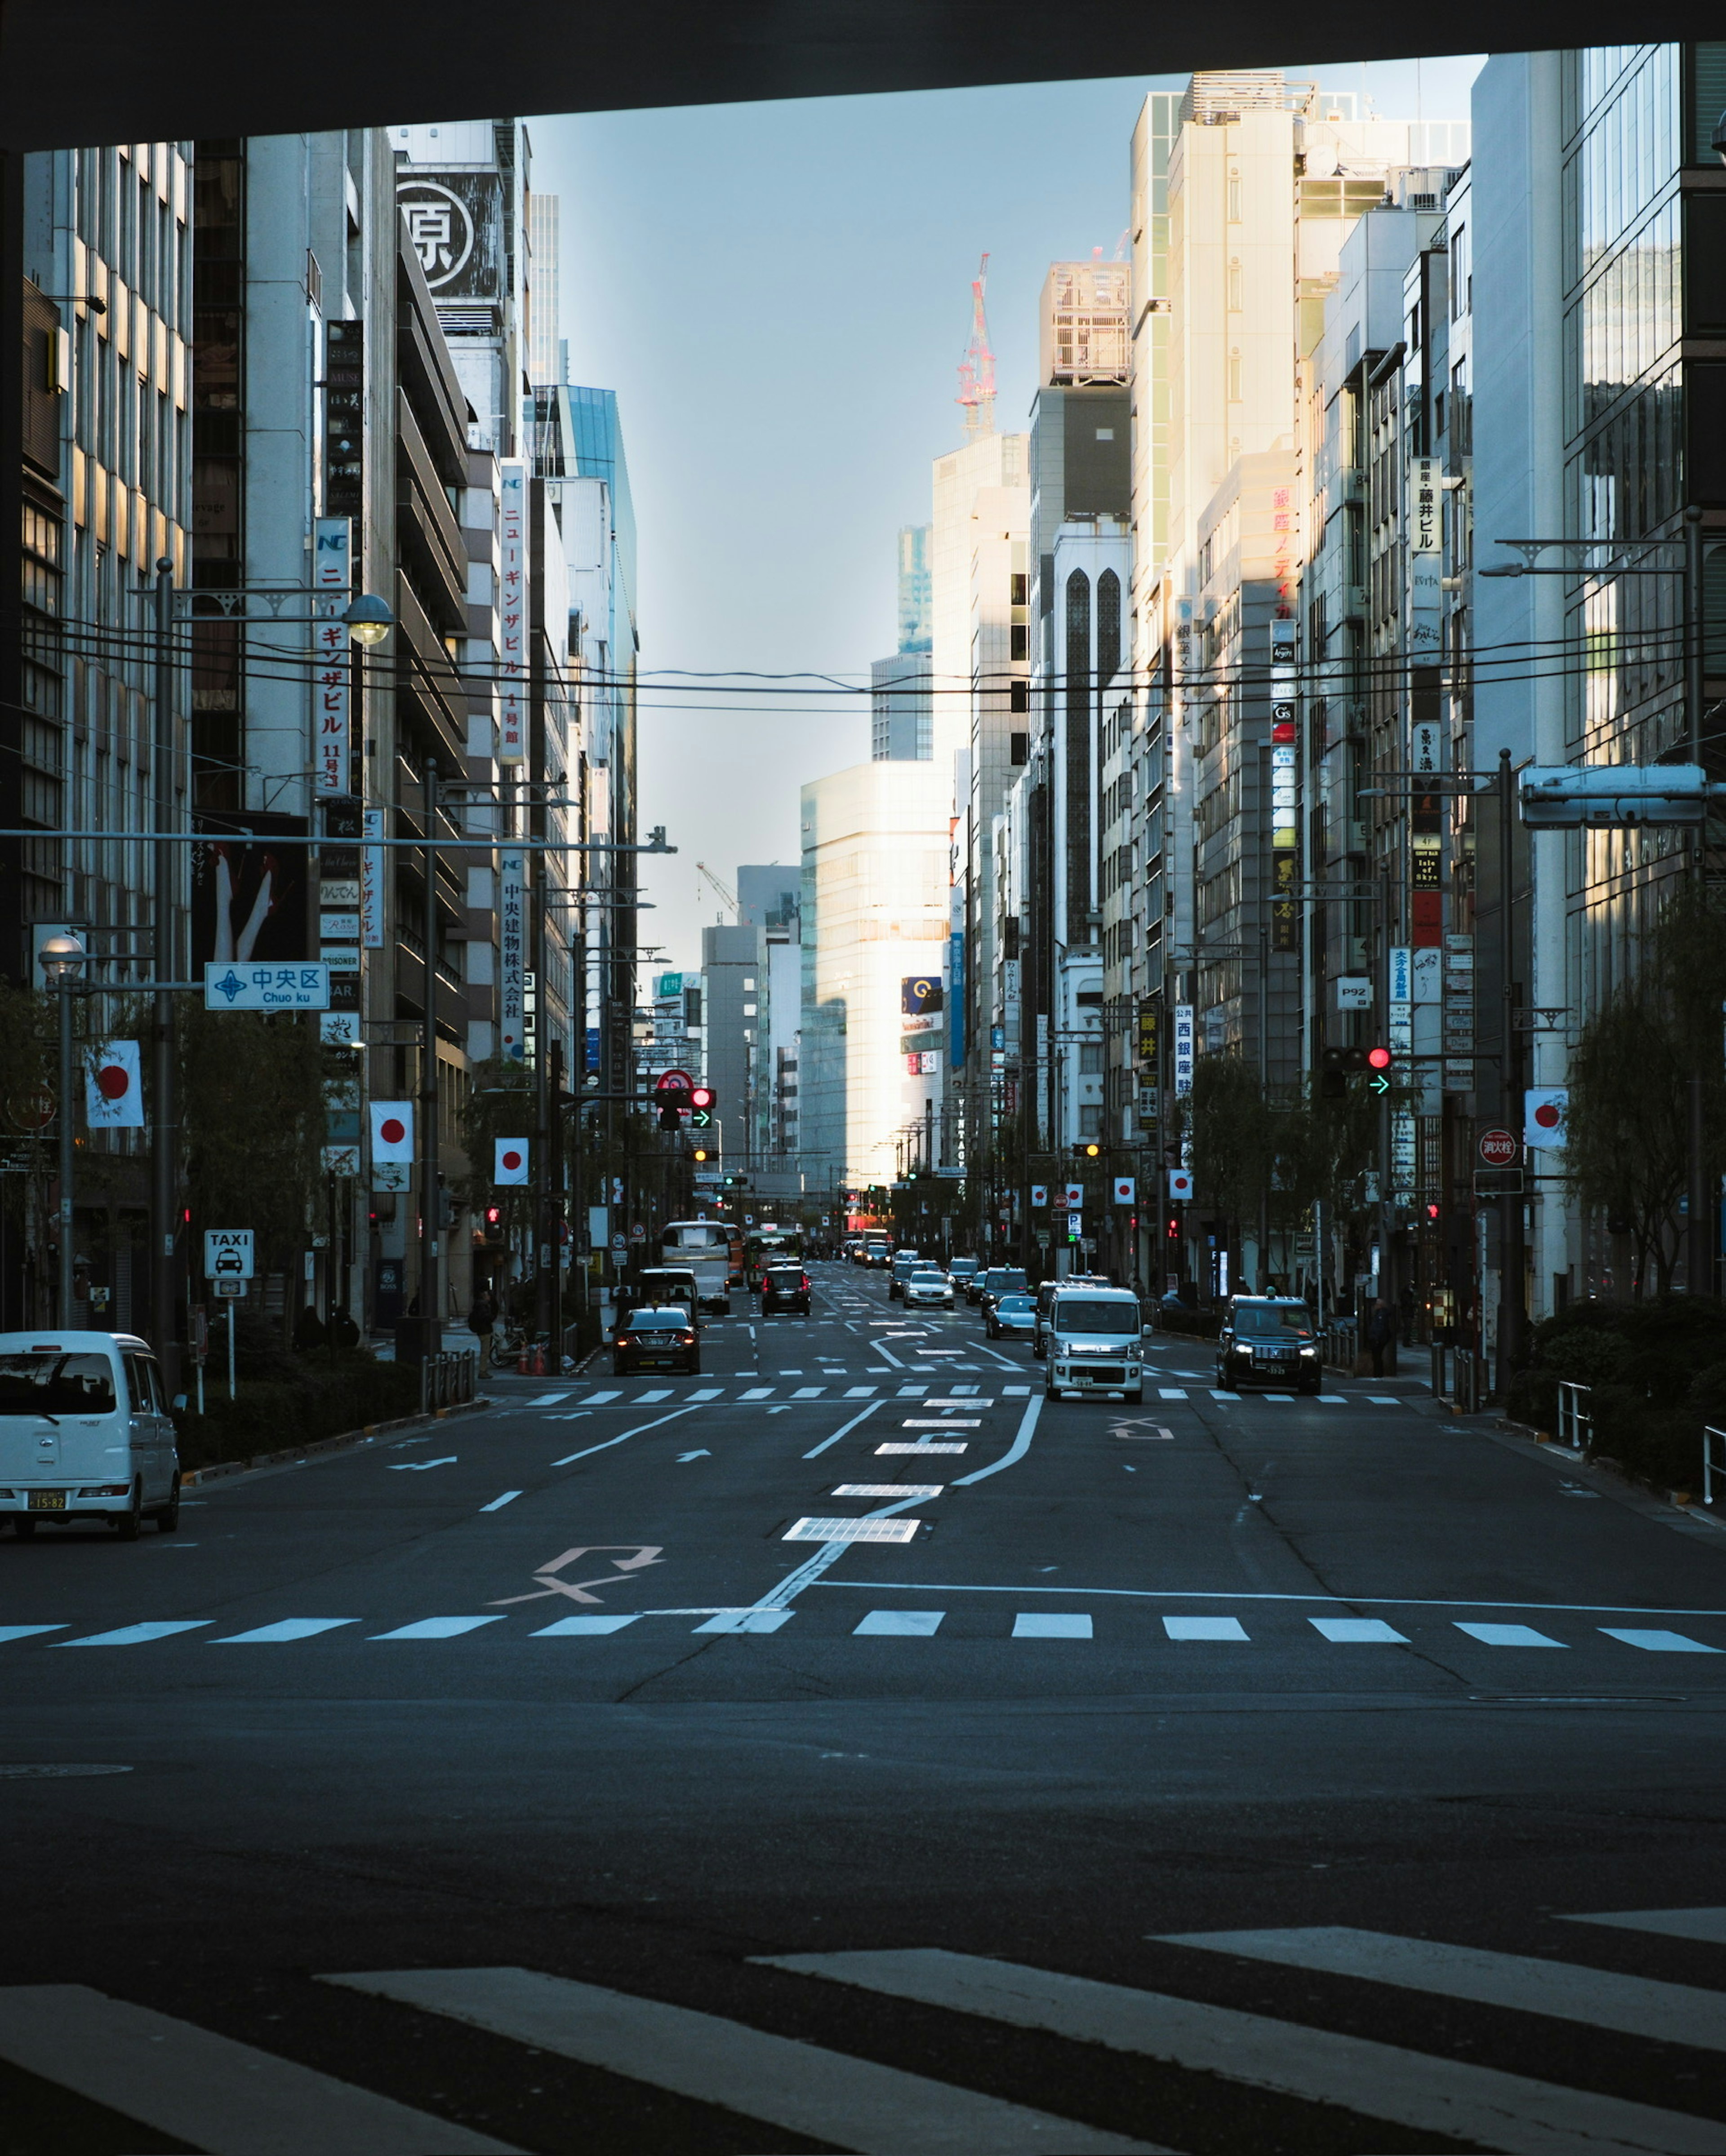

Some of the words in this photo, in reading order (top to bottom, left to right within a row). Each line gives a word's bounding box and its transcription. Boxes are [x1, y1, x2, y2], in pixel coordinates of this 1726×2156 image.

[401, 202, 452, 271] 原
[1419, 460, 1433, 548] 銀座・藤井ビル
[504, 883, 520, 1019] 中央建物株式会社
[253, 969, 320, 989] 中央区
[1395, 951, 1407, 999] 大分合同新聞
[263, 992, 292, 1003] Chuo
[297, 992, 310, 1003] ku
[1484, 1140, 1512, 1154] 消火栓
[1070, 1216, 1077, 1225] P
[210, 1235, 248, 1246] TAXI
[37, 1498, 65, 1508] 15-82
